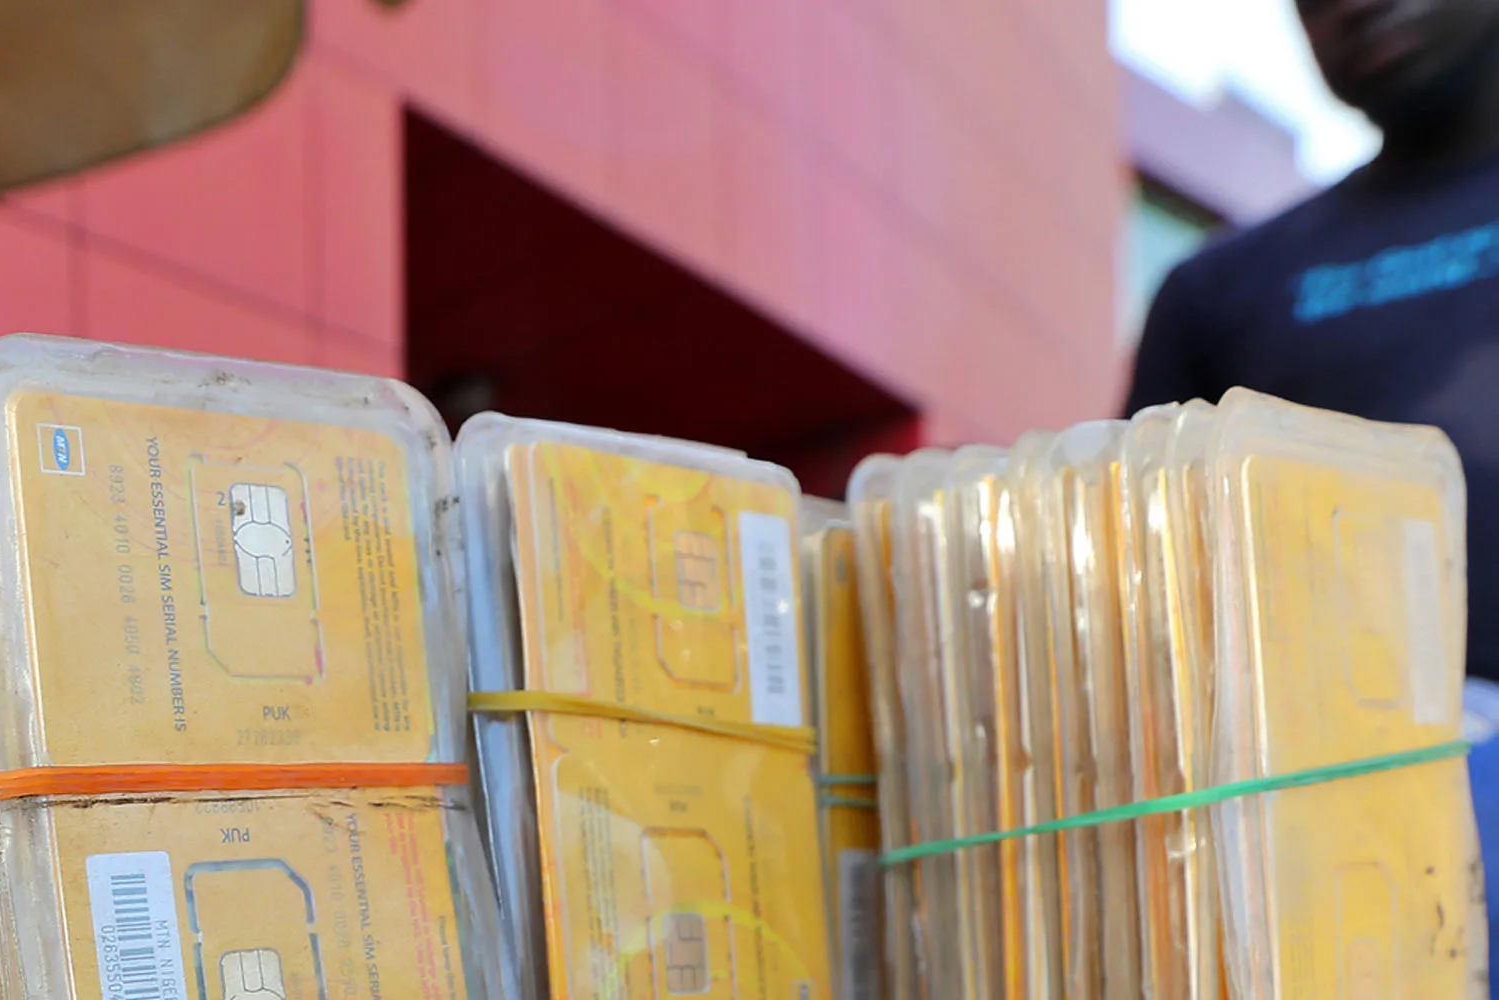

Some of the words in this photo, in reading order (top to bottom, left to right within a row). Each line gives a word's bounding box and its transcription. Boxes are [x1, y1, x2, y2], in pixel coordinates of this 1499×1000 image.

[145, 436, 163, 479] YOUR
[149, 481, 170, 561] ESSENTIAL
[157, 564, 173, 592] SIM
[161, 595, 179, 646] SERIAL
[167, 649, 185, 715] NUMBER
[173, 717, 188, 732] IS
[262, 705, 291, 721] PUK
[219, 827, 251, 844] PUK
[345, 812, 361, 854] YOUR
[350, 855, 372, 930] ESSENTIAL
[155, 920, 171, 949] MTN
[362, 934, 377, 961] SIM
